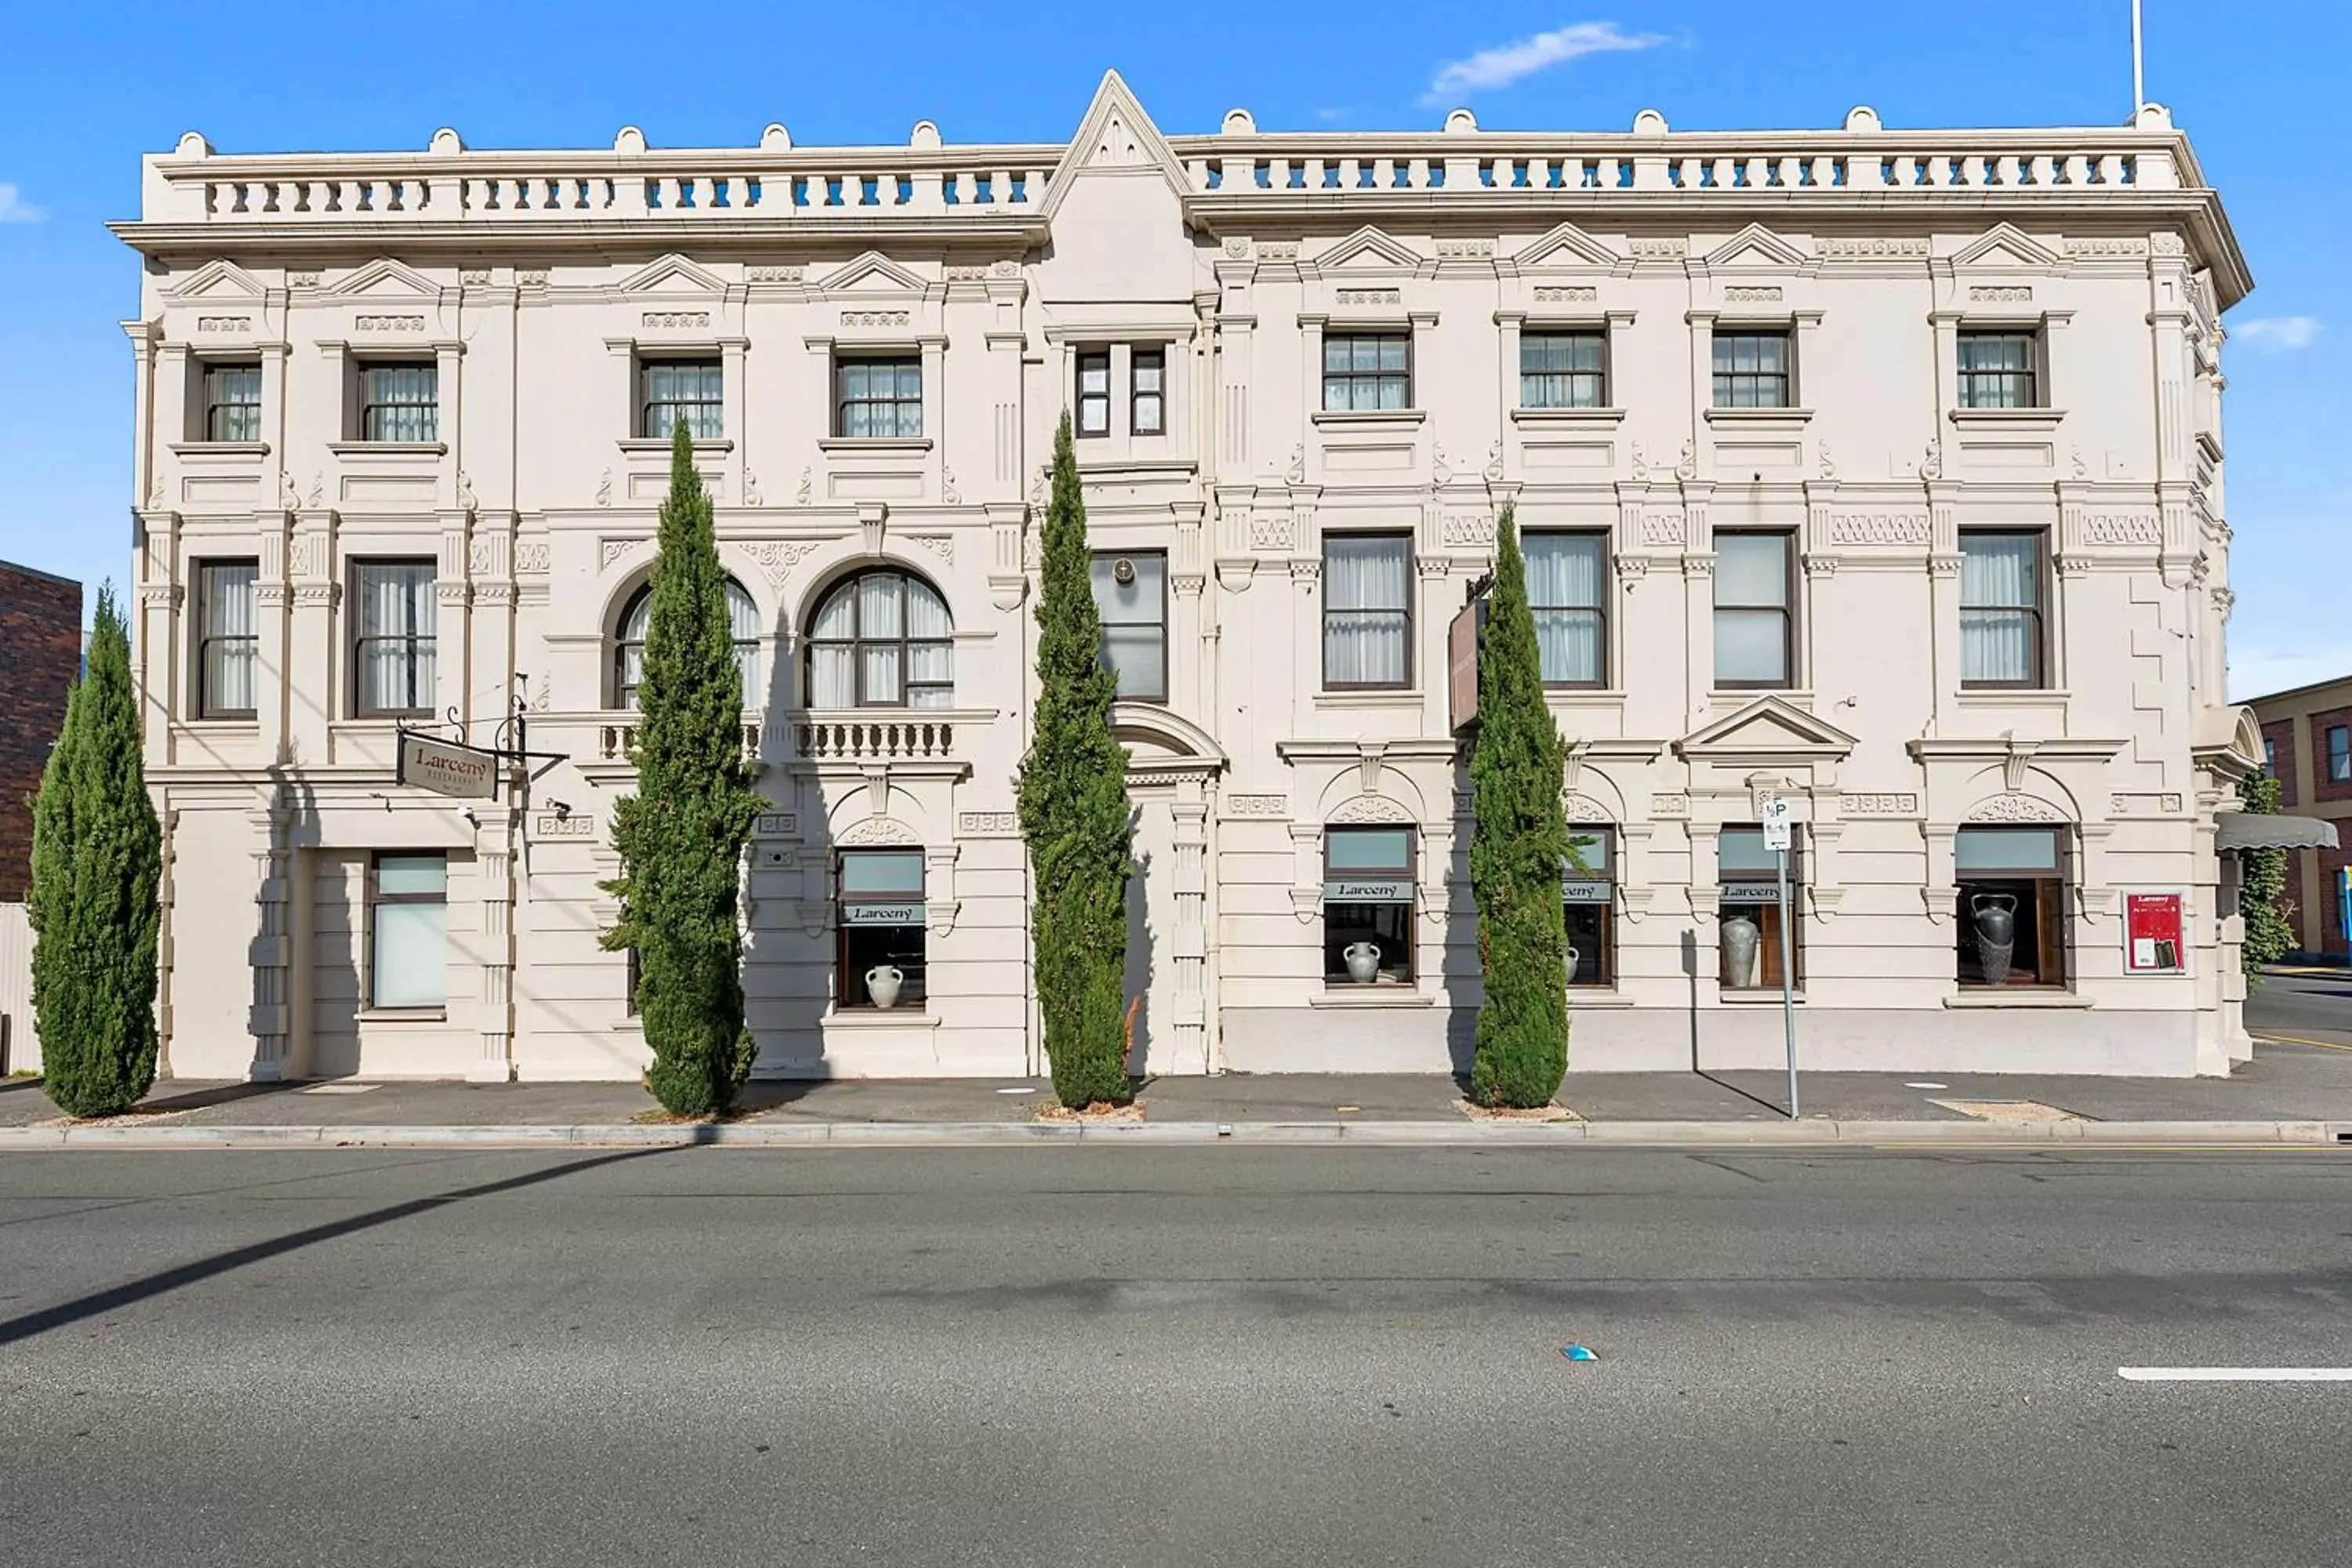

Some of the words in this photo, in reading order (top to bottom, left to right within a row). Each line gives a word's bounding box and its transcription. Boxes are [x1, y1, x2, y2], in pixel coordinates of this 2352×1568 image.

[416, 748, 487, 781] Larceny
[1338, 884, 1398, 897] Larceny
[1562, 887, 1595, 898] ceny
[854, 908, 913, 920] Larceny
